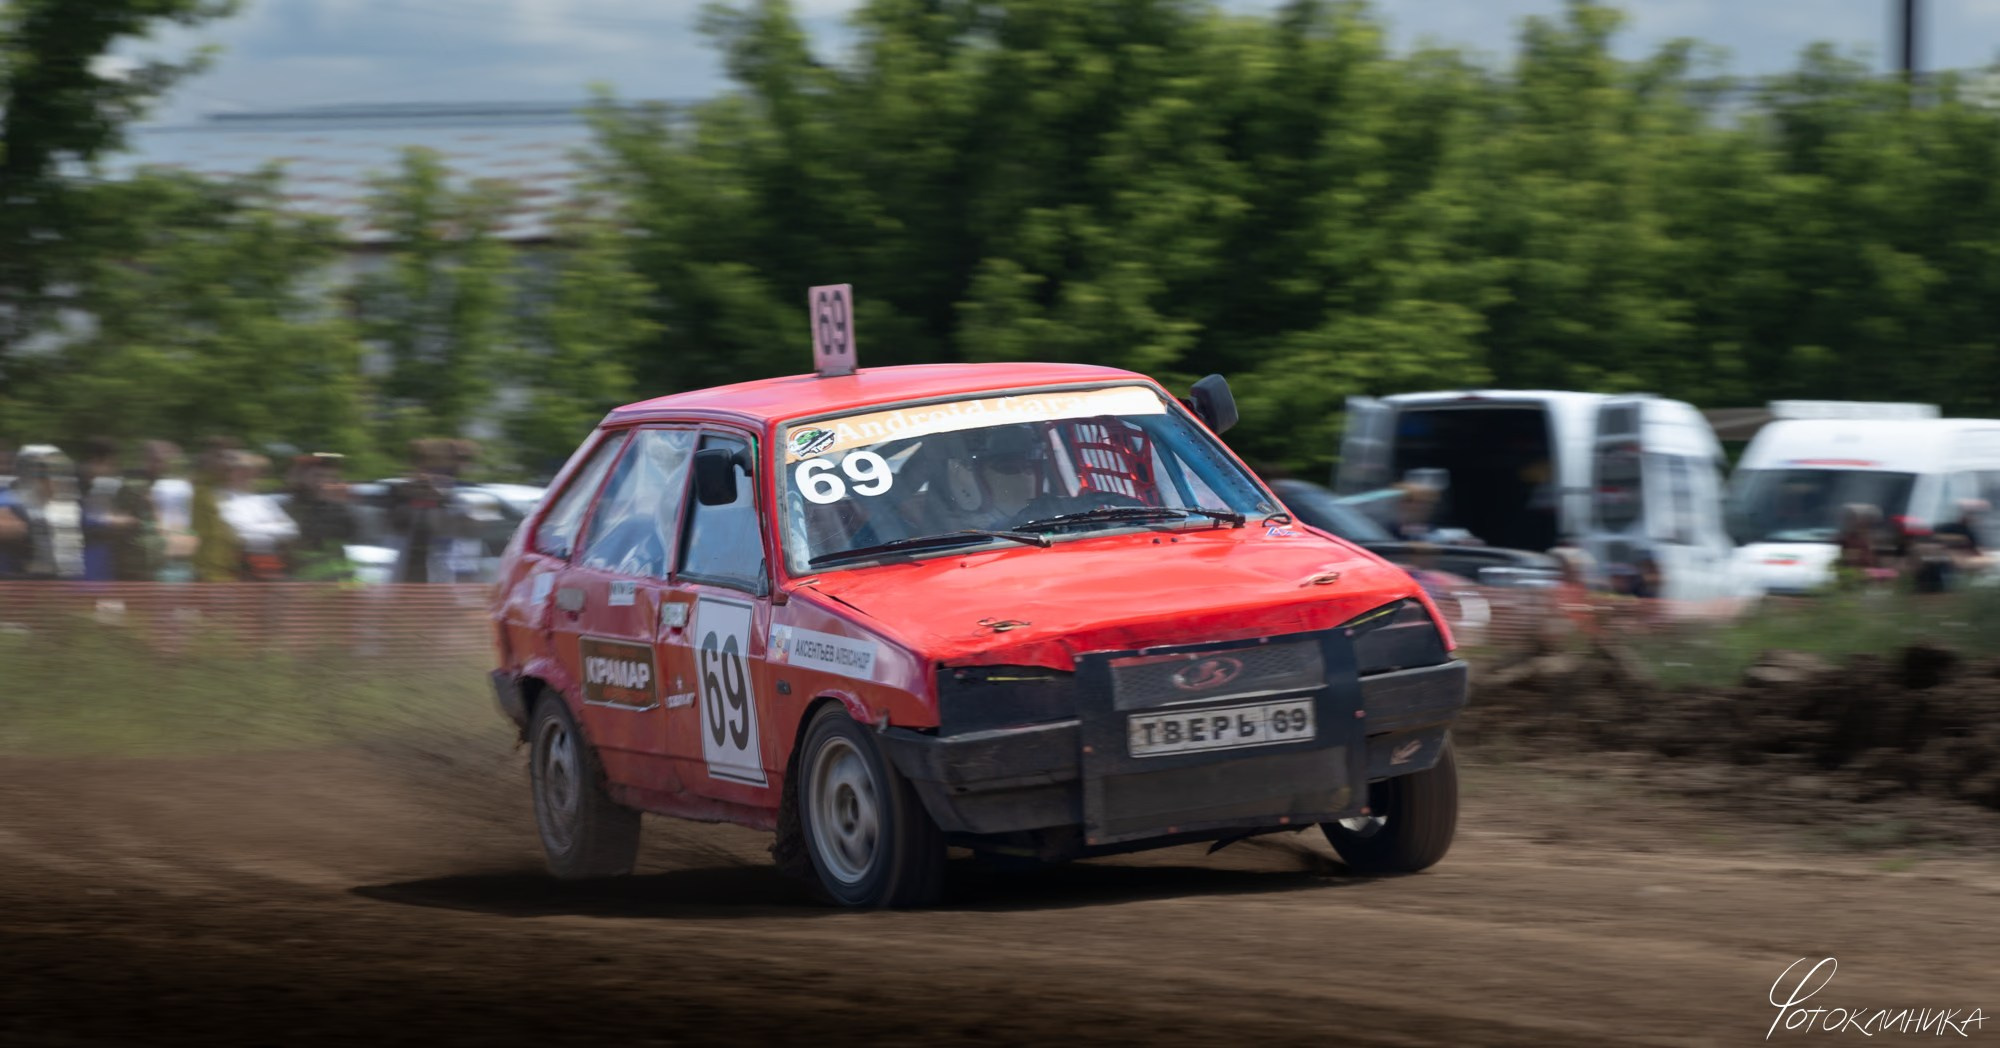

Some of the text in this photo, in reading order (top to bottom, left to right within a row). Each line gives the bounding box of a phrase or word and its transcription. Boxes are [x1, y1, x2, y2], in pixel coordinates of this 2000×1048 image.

[817, 290, 848, 355] 69
[834, 402, 984, 441] Android
[795, 450, 893, 504] 69
[795, 638, 835, 663] АКСЕНТЬЕВ
[587, 656, 651, 690] КРАМАР
[702, 631, 749, 751] 69
[1142, 707, 1307, 747] ТВЕРЬ 69
